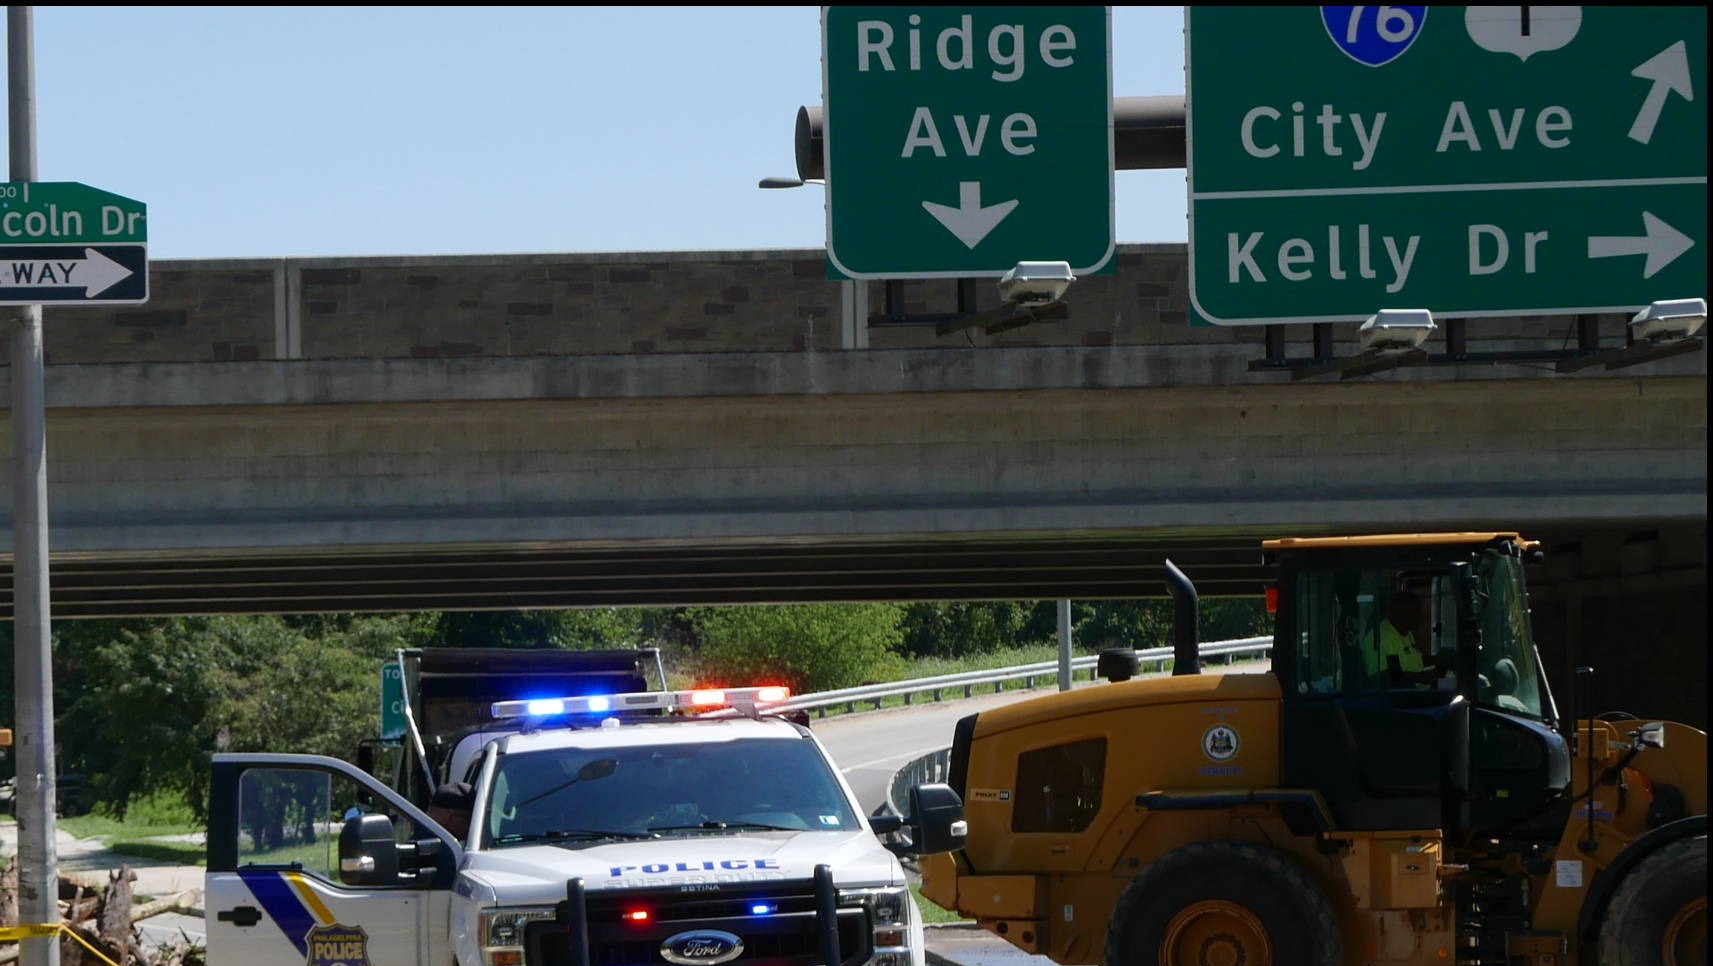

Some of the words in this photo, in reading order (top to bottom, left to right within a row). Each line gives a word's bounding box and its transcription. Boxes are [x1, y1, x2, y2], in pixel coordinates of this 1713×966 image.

[856, 16, 1079, 81] Ridge
[901, 106, 1039, 157] Ave
[1240, 103, 1388, 170] City
[1436, 100, 1573, 152] Ave
[102, 205, 142, 236] Dr
[1227, 224, 1422, 292] Kelly
[1469, 223, 1549, 275] Dr
[12, 262, 77, 285] WAY
[609, 859, 780, 877] POLICE
[315, 942, 363, 960] POLICE
[683, 939, 722, 957] Ford
